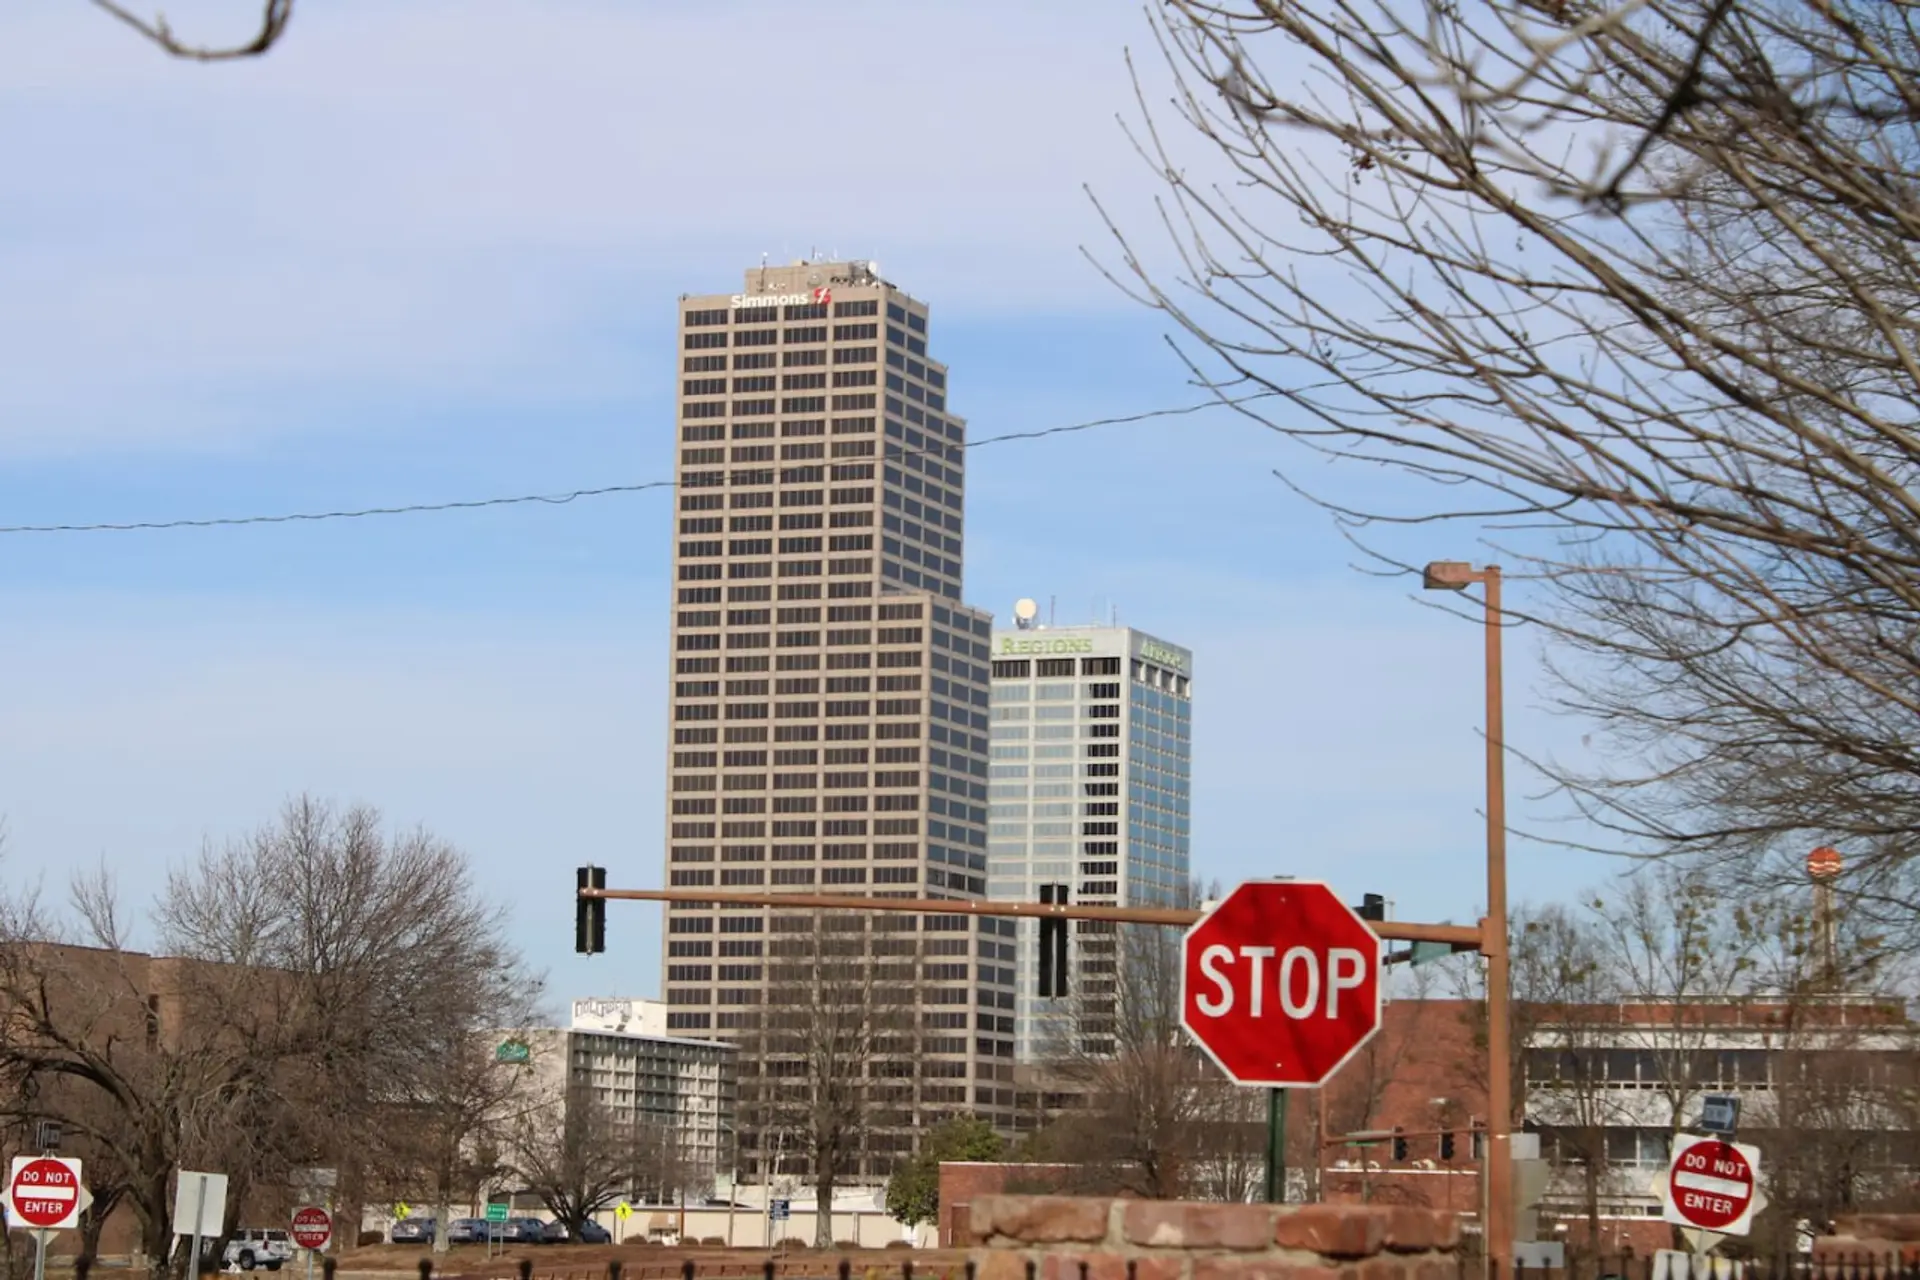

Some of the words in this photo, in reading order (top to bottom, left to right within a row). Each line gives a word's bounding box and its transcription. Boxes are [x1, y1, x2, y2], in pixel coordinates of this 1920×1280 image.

[730, 293, 808, 309] Simmons
[1195, 943, 1367, 1020] STOP
[1684, 1153, 1706, 1170] DO
[1713, 1159, 1746, 1178] NOT
[22, 1171, 39, 1182] DO
[45, 1172, 71, 1184] NOT
[24, 1201, 63, 1214] ENTER
[1684, 1193, 1733, 1215] ENTER
